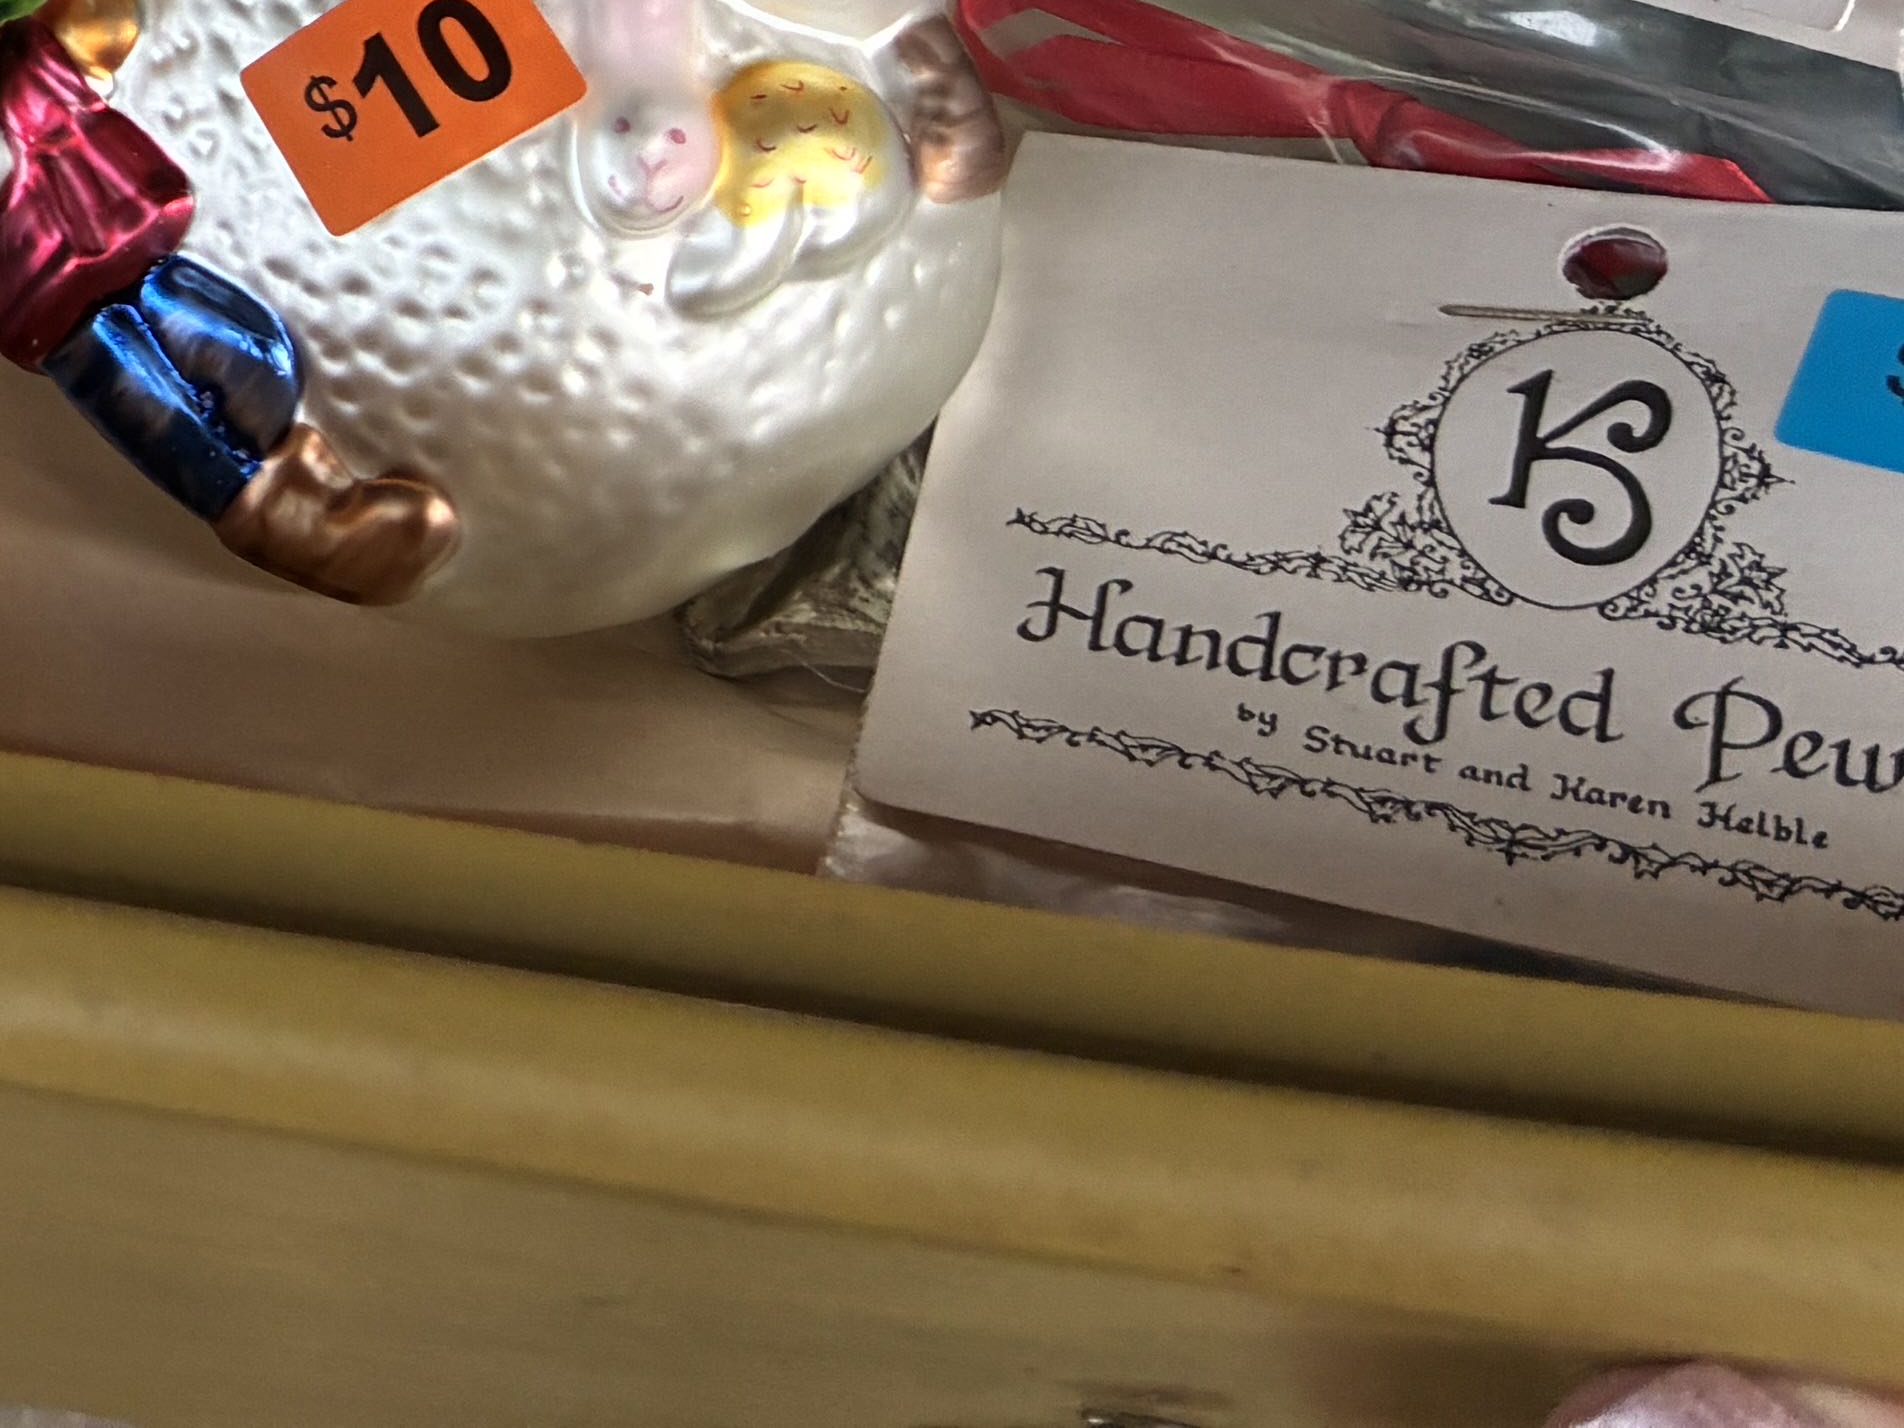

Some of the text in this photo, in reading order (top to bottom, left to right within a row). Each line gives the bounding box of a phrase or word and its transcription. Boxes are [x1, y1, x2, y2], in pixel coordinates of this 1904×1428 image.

[1016, 566, 1625, 746] Handcrafted
[1237, 702, 1278, 738] by
[1302, 725, 1443, 774] Stuart
[1458, 763, 1532, 792] and
[1550, 773, 1671, 820] Karen
